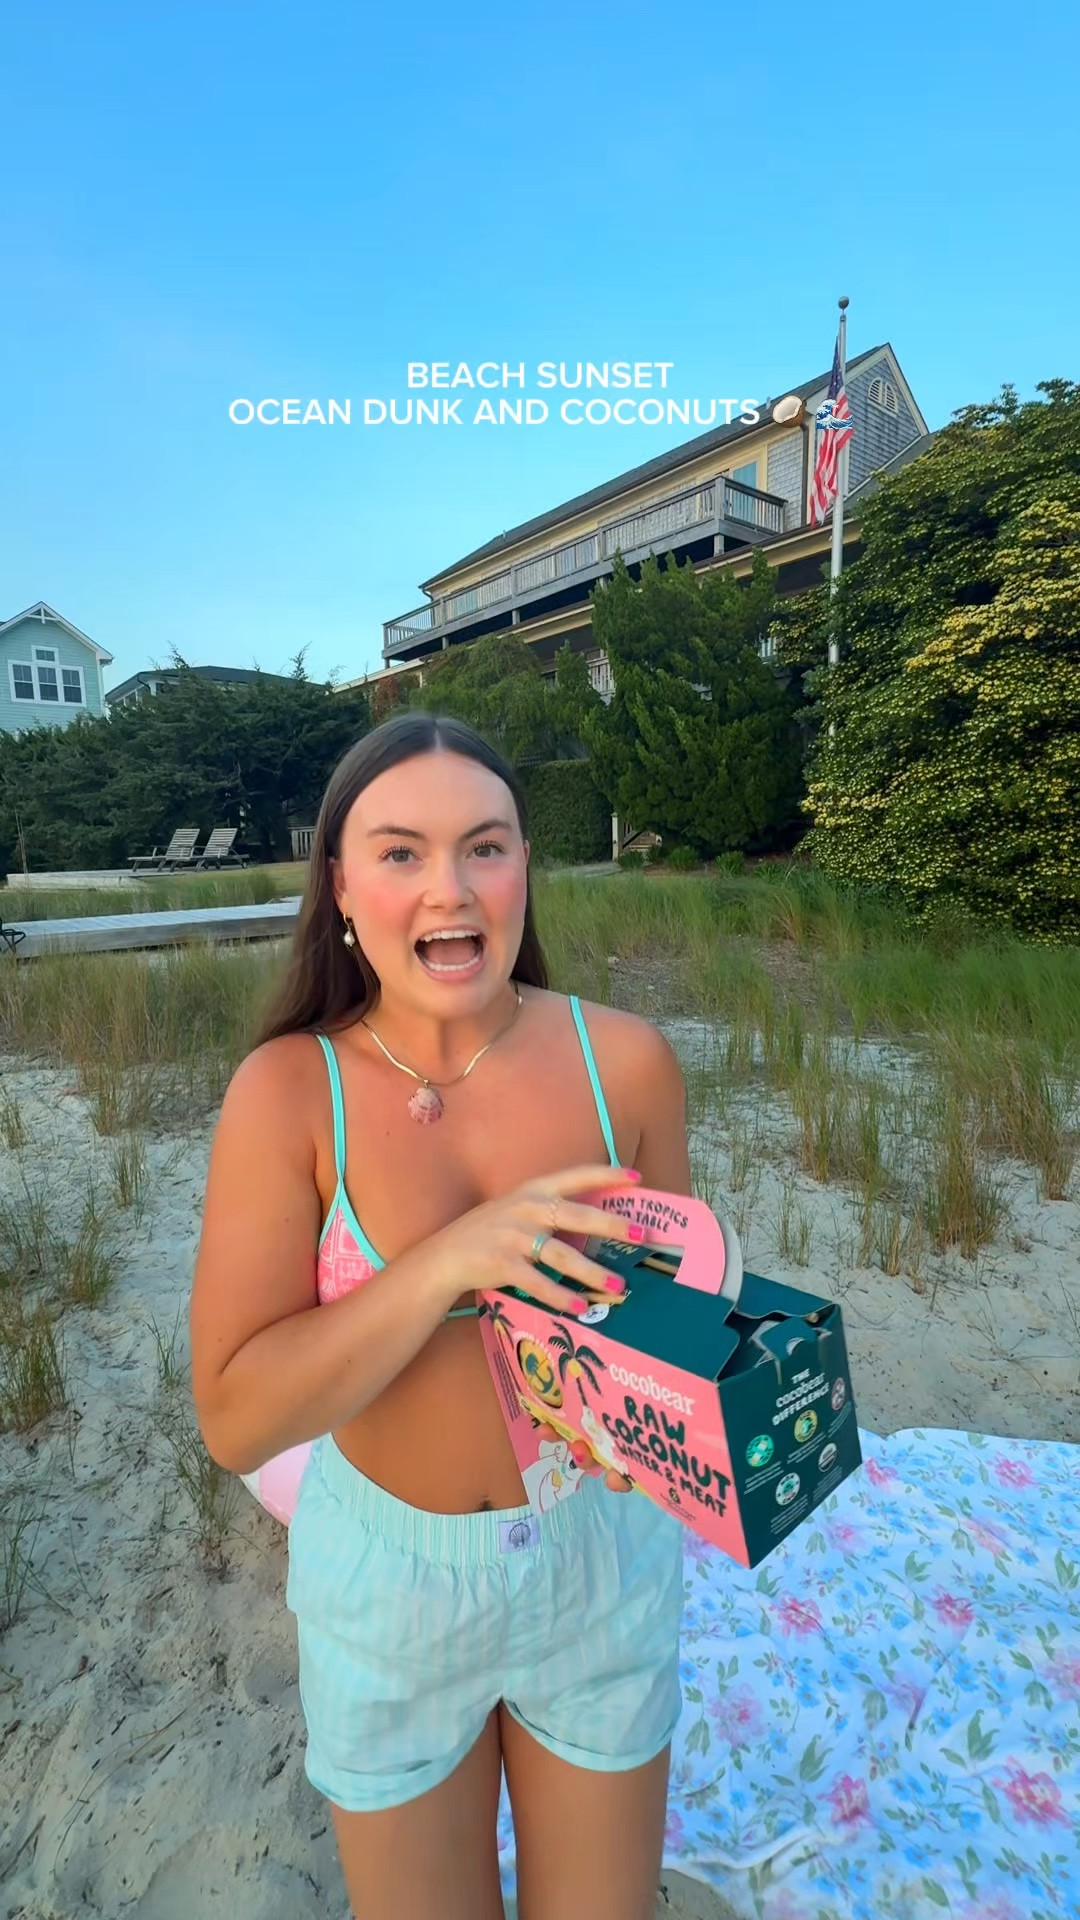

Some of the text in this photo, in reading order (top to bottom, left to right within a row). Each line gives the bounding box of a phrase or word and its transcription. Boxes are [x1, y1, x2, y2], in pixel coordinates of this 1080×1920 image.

[636, 1211, 669, 1233] TABLE
[640, 1199, 689, 1229] TROPICS
[609, 1363, 696, 1416] cocobear
[624, 1395, 685, 1446] RAW
[602, 1413, 731, 1500] COCONUT
[613, 1439, 663, 1477] WATER
[679, 1475, 728, 1518] MEAT
